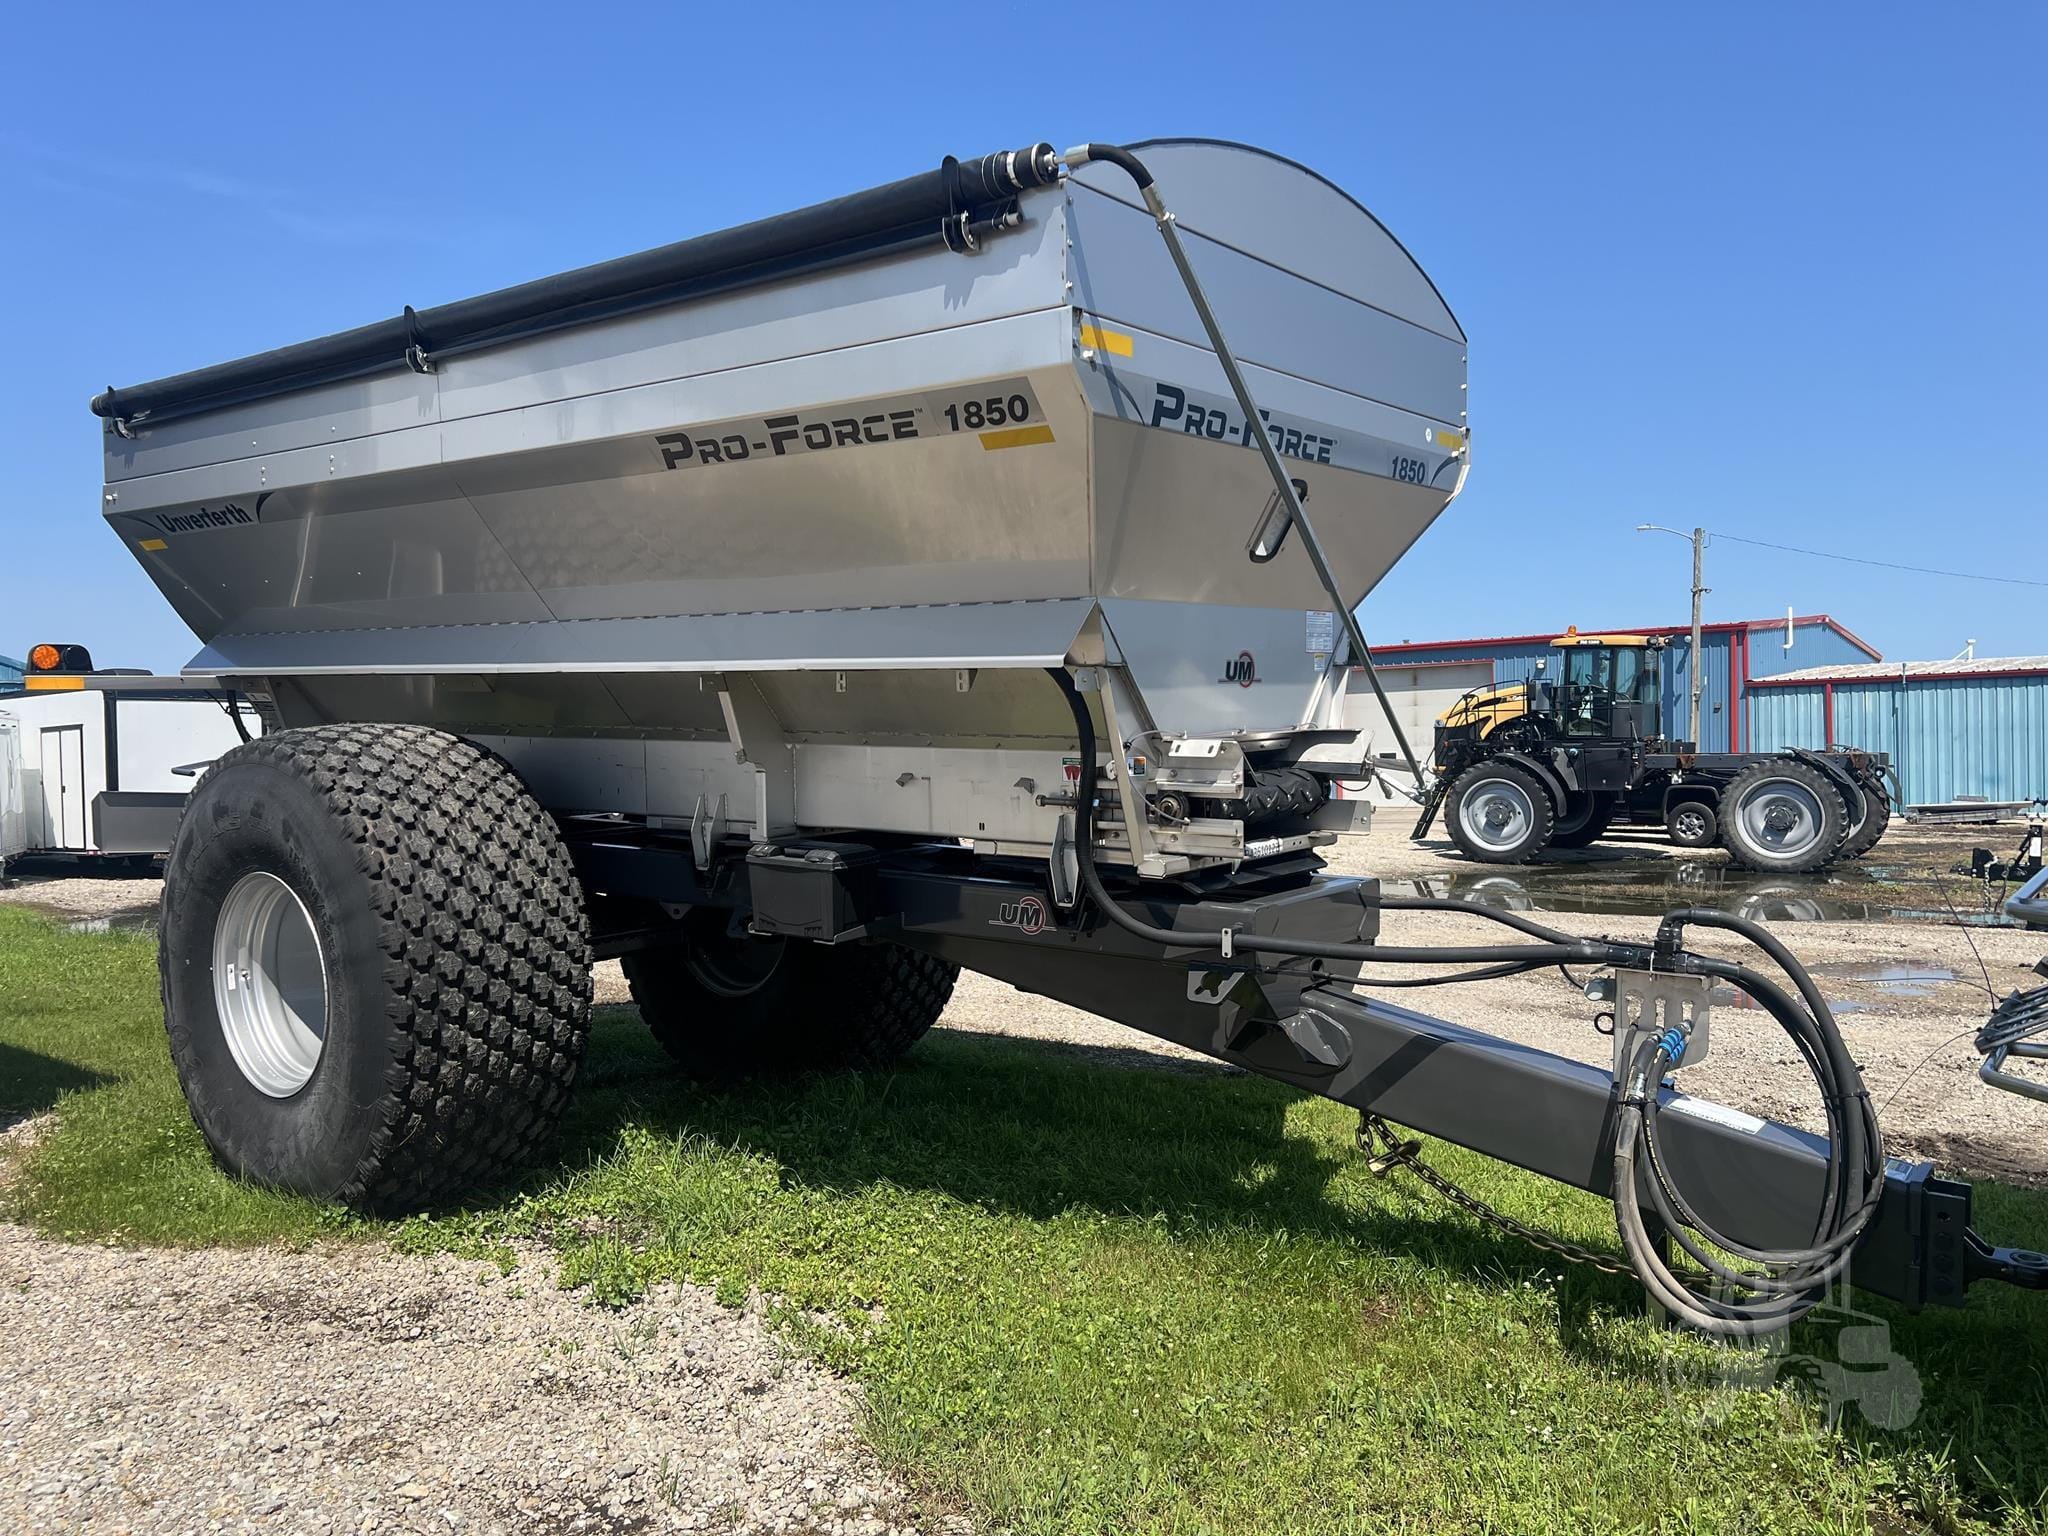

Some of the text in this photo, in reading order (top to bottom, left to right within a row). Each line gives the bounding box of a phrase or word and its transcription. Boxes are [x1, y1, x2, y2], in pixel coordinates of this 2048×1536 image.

[655, 410, 919, 470] PRO-FORCE
[944, 394, 1029, 432] 1850
[1391, 456, 1426, 484] 1850
[156, 503, 253, 533] Unverferth
